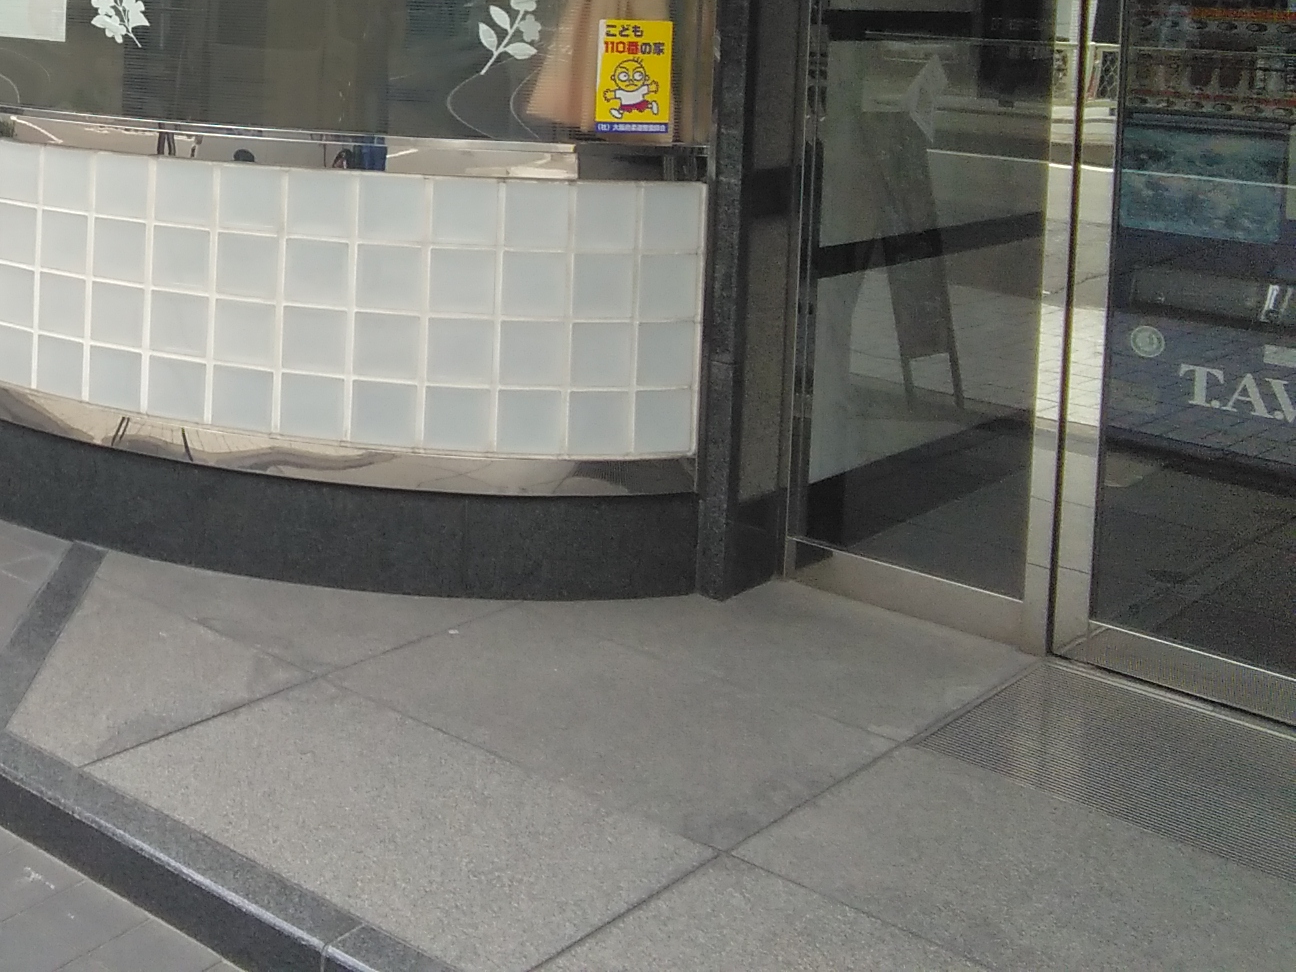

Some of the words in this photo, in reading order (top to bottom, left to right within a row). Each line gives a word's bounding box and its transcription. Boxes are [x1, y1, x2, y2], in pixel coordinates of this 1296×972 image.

[605, 24, 644, 38] こども
[604, 41, 665, 56] 110番の家
